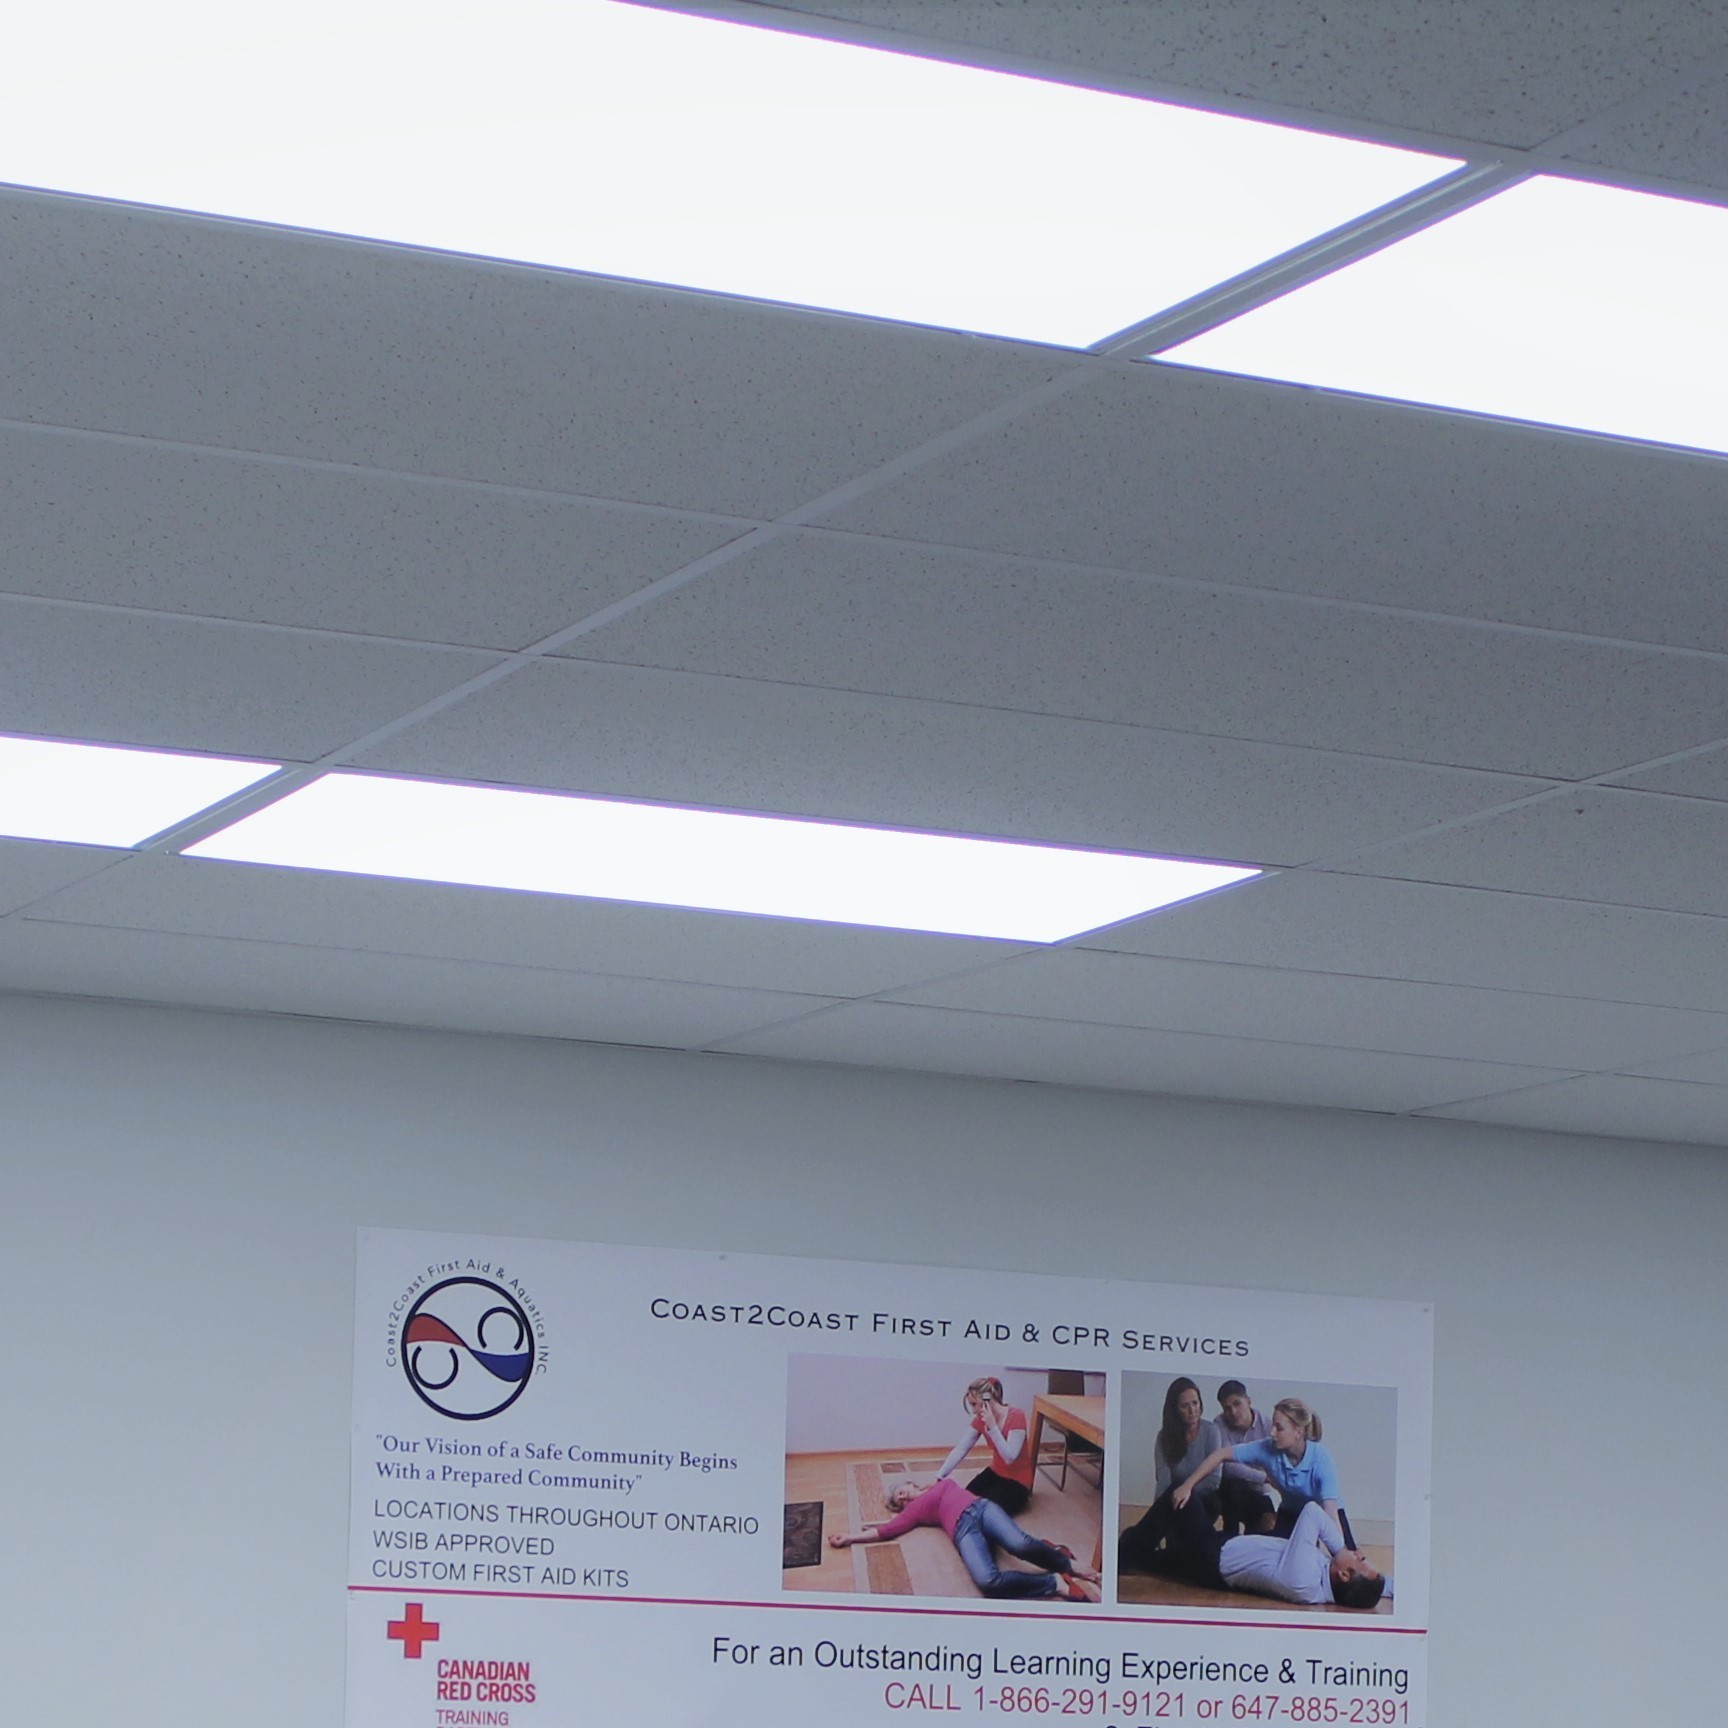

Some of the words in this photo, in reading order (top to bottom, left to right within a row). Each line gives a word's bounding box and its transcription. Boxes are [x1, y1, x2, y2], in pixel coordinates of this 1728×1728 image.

[386, 1276, 426, 1367] Coast2Coast
[427, 1260, 460, 1277] First
[467, 1259, 490, 1272] Aid
[496, 1267, 504, 1279] &
[508, 1278, 545, 1339] Aquatics
[536, 1345, 549, 1375] INC
[376, 1435, 420, 1454] "Our
[425, 1436, 482, 1458] Vision
[487, 1440, 507, 1458] of
[510, 1447, 520, 1458] a
[525, 1442, 563, 1462] Safe
[568, 1444, 674, 1471] Community
[679, 1449, 738, 1472] Begins
[376, 1462, 422, 1482] With
[426, 1469, 436, 1481] a
[440, 1465, 523, 1488] Prepared
[528, 1469, 642, 1494] Community"
[374, 1499, 499, 1523] LOCATIONS
[506, 1504, 657, 1531] THROUGHOUT
[664, 1513, 760, 1535] ONTARIO
[373, 1530, 429, 1551] WSIB
[434, 1533, 555, 1556] APPROVED
[372, 1559, 466, 1581] CUSTOM
[473, 1564, 534, 1584] FIRST
[541, 1567, 577, 1585] AID
[583, 1569, 629, 1588] KITS
[437, 1659, 530, 1681] CANADIAN
[712, 1638, 761, 1666] For
[770, 1646, 804, 1668] an
[813, 1641, 983, 1680] Outstanding
[992, 1648, 1111, 1684] Learning
[1121, 1652, 1269, 1688] Experience
[1277, 1658, 1297, 1684] &
[1306, 1658, 1409, 1694] Training
[437, 1681, 472, 1701] RED
[475, 1682, 536, 1703] CROSS
[884, 1681, 961, 1713] CALL
[974, 1687, 1186, 1718] 1-866-291-9121
[1197, 1698, 1223, 1718] or
[1231, 1693, 1411, 1725] 647-885-2391
[436, 1709, 509, 1726] TRAINING
